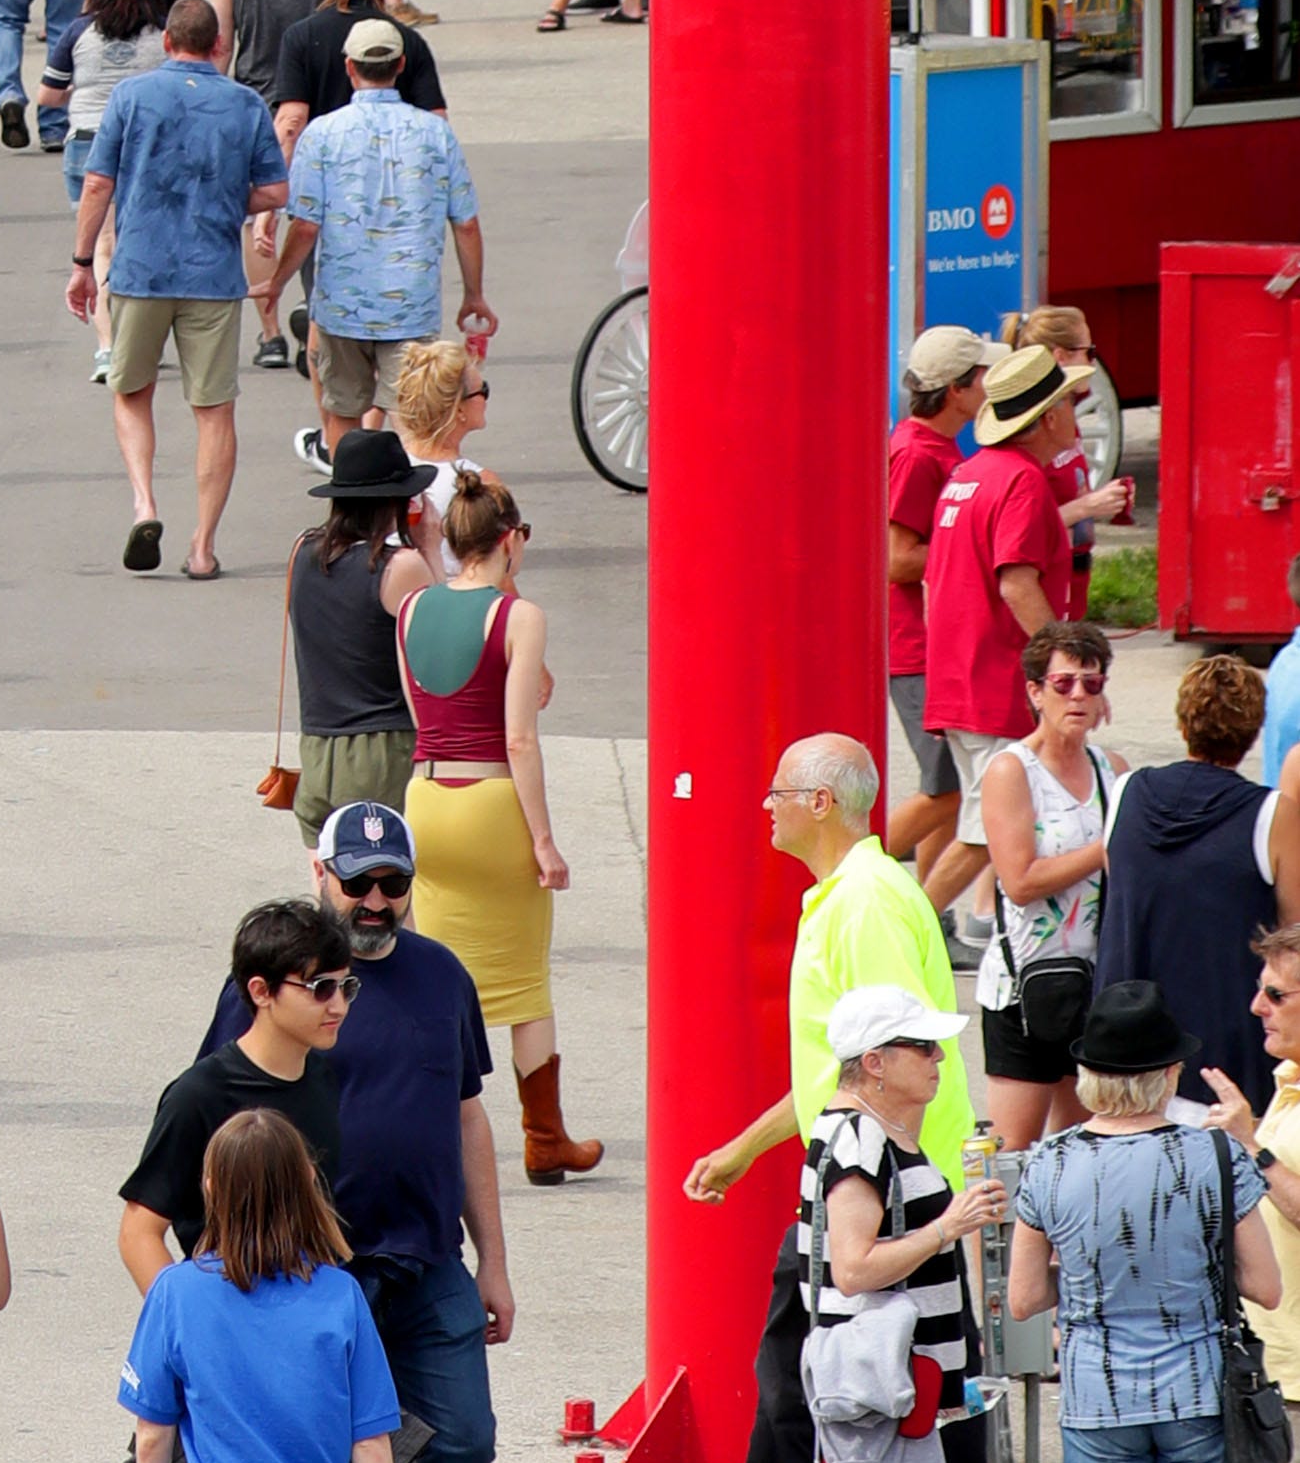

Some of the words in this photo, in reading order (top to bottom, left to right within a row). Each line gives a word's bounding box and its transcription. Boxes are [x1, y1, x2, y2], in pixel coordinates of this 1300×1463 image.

[927, 207, 976, 232] BMO
[928, 252, 955, 273] We're
[957, 255, 980, 271] here
[981, 254, 993, 268] to
